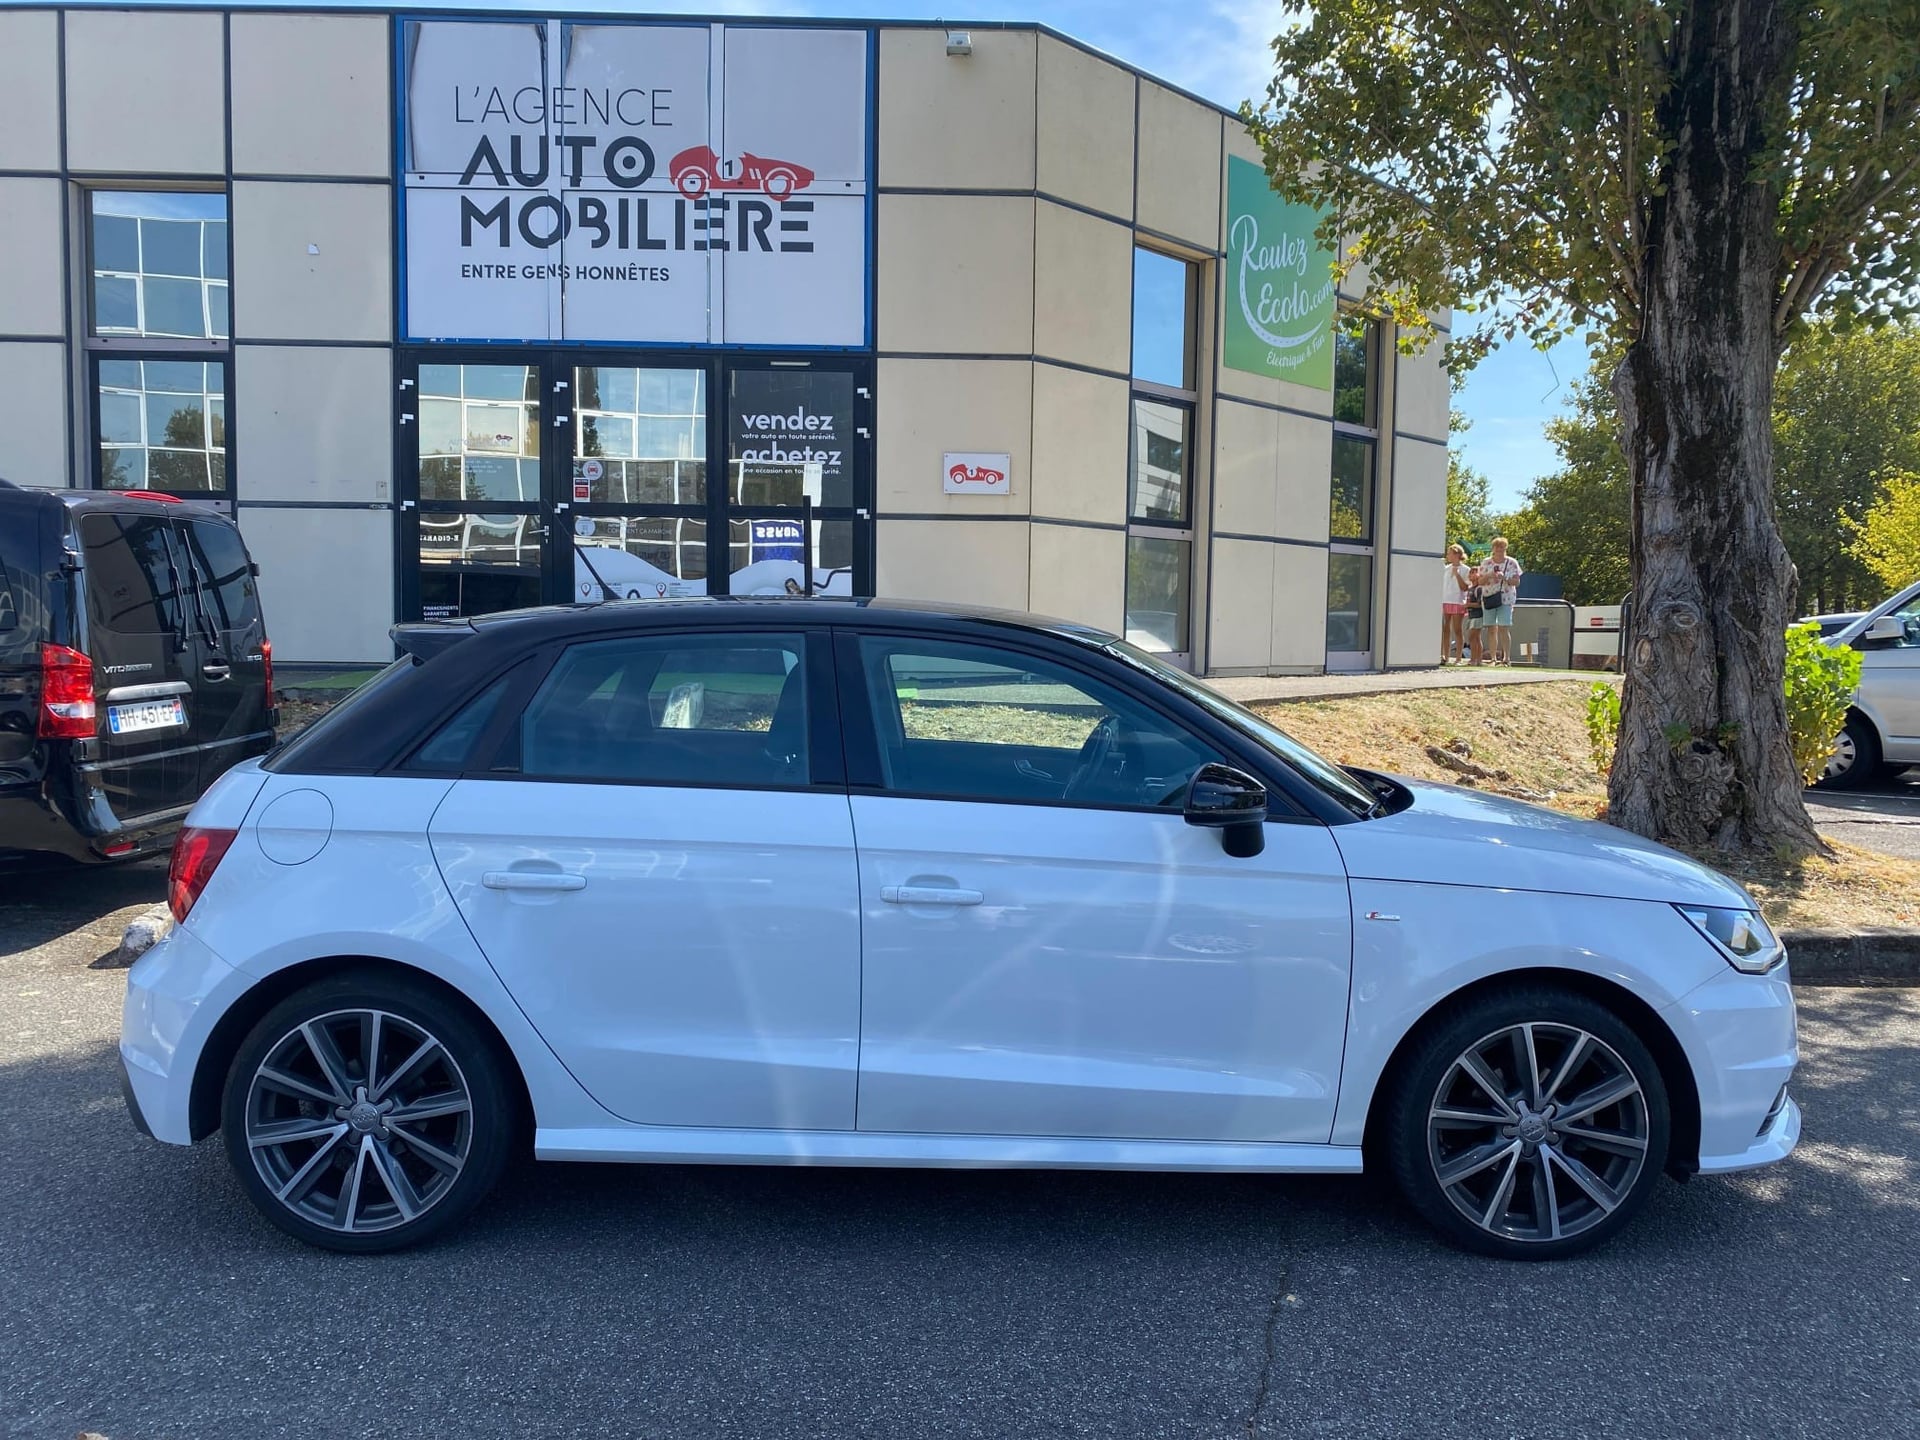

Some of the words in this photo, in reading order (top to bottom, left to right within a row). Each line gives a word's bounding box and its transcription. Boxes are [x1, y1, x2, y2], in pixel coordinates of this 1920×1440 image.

[458, 134, 656, 188] AUTO
[724, 159, 734, 177] 1
[460, 194, 815, 254] MOBILIERE
[1231, 214, 1308, 276] Roulez
[461, 264, 517, 279] ENTRE
[521, 263, 570, 280] GENS
[576, 262, 670, 282] HONNÊTES
[741, 405, 834, 431] vendez
[741, 432, 759, 440] votre
[760, 432, 777, 440] auto
[788, 432, 807, 440] toute
[741, 440, 842, 466] achetez
[755, 466, 783, 475] occasion
